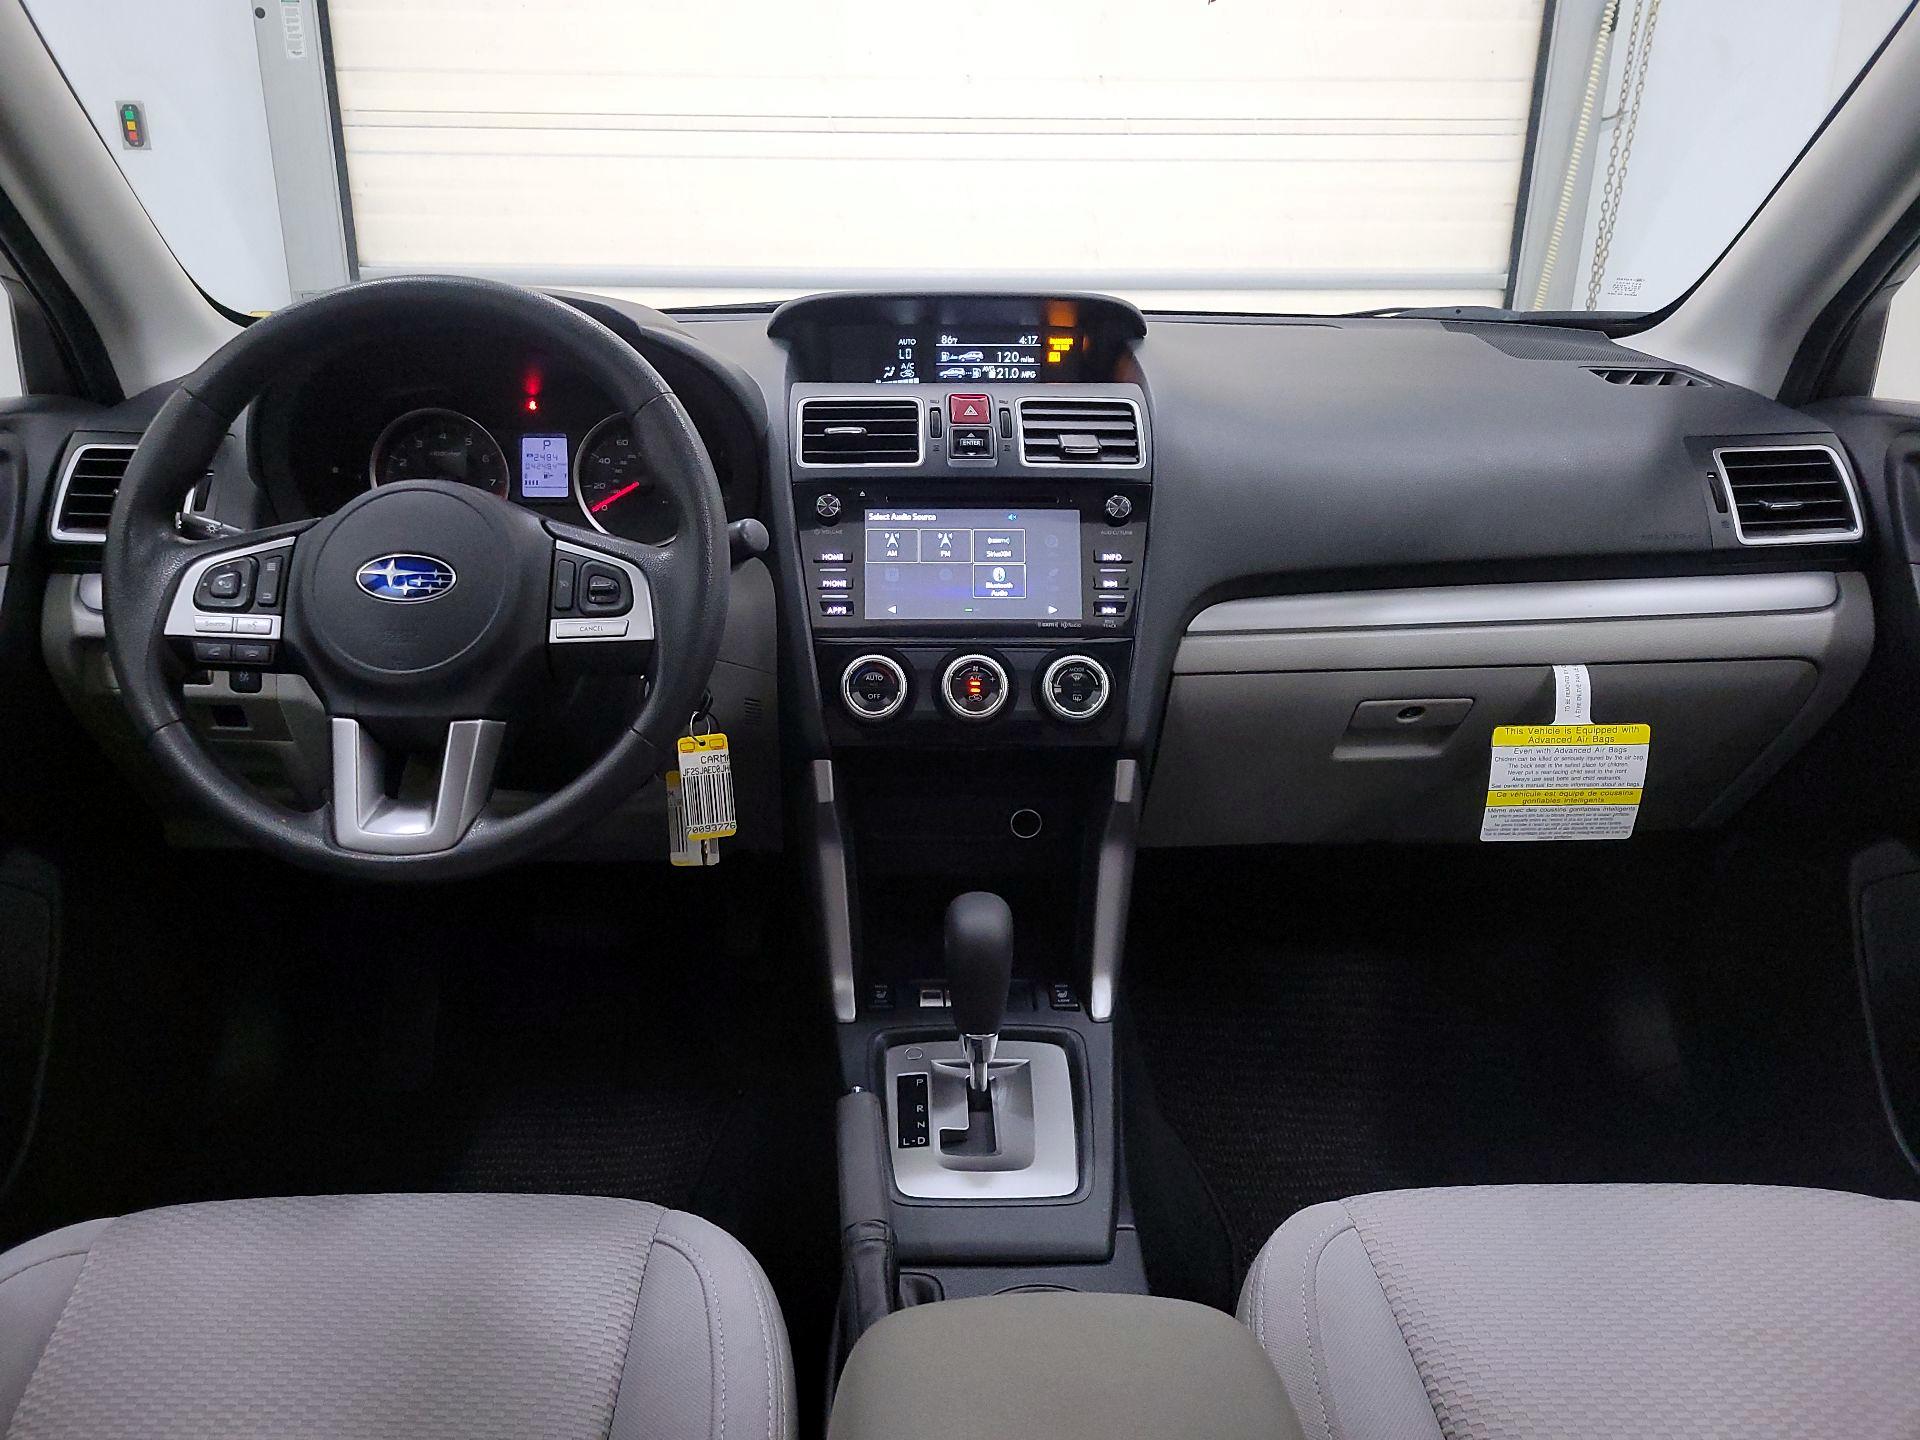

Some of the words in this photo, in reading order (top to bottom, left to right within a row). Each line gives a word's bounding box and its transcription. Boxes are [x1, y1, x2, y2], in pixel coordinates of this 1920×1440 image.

[1019, 335, 1038, 344] 4:17
[996, 352, 1020, 362] 120
[1021, 370, 1036, 379] MPG
[416, 440, 423, 448] 3
[465, 438, 472, 446] 5
[543, 440, 551, 450] P
[400, 459, 407, 467] 2
[868, 512, 890, 520] Select
[891, 512, 912, 520] Audio
[912, 512, 937, 520] Source
[822, 553, 844, 561] HOME
[940, 550, 951, 558] FM
[1102, 553, 1122, 561] INFO
[822, 580, 847, 588] PHONE
[827, 606, 847, 614] APPS
[1505, 727, 1523, 735] This
[1528, 727, 1560, 735] Vehicle
[1576, 726, 1618, 735] Equipped
[1528, 736, 1572, 744] Advanced
[685, 822, 736, 834] 70093776
